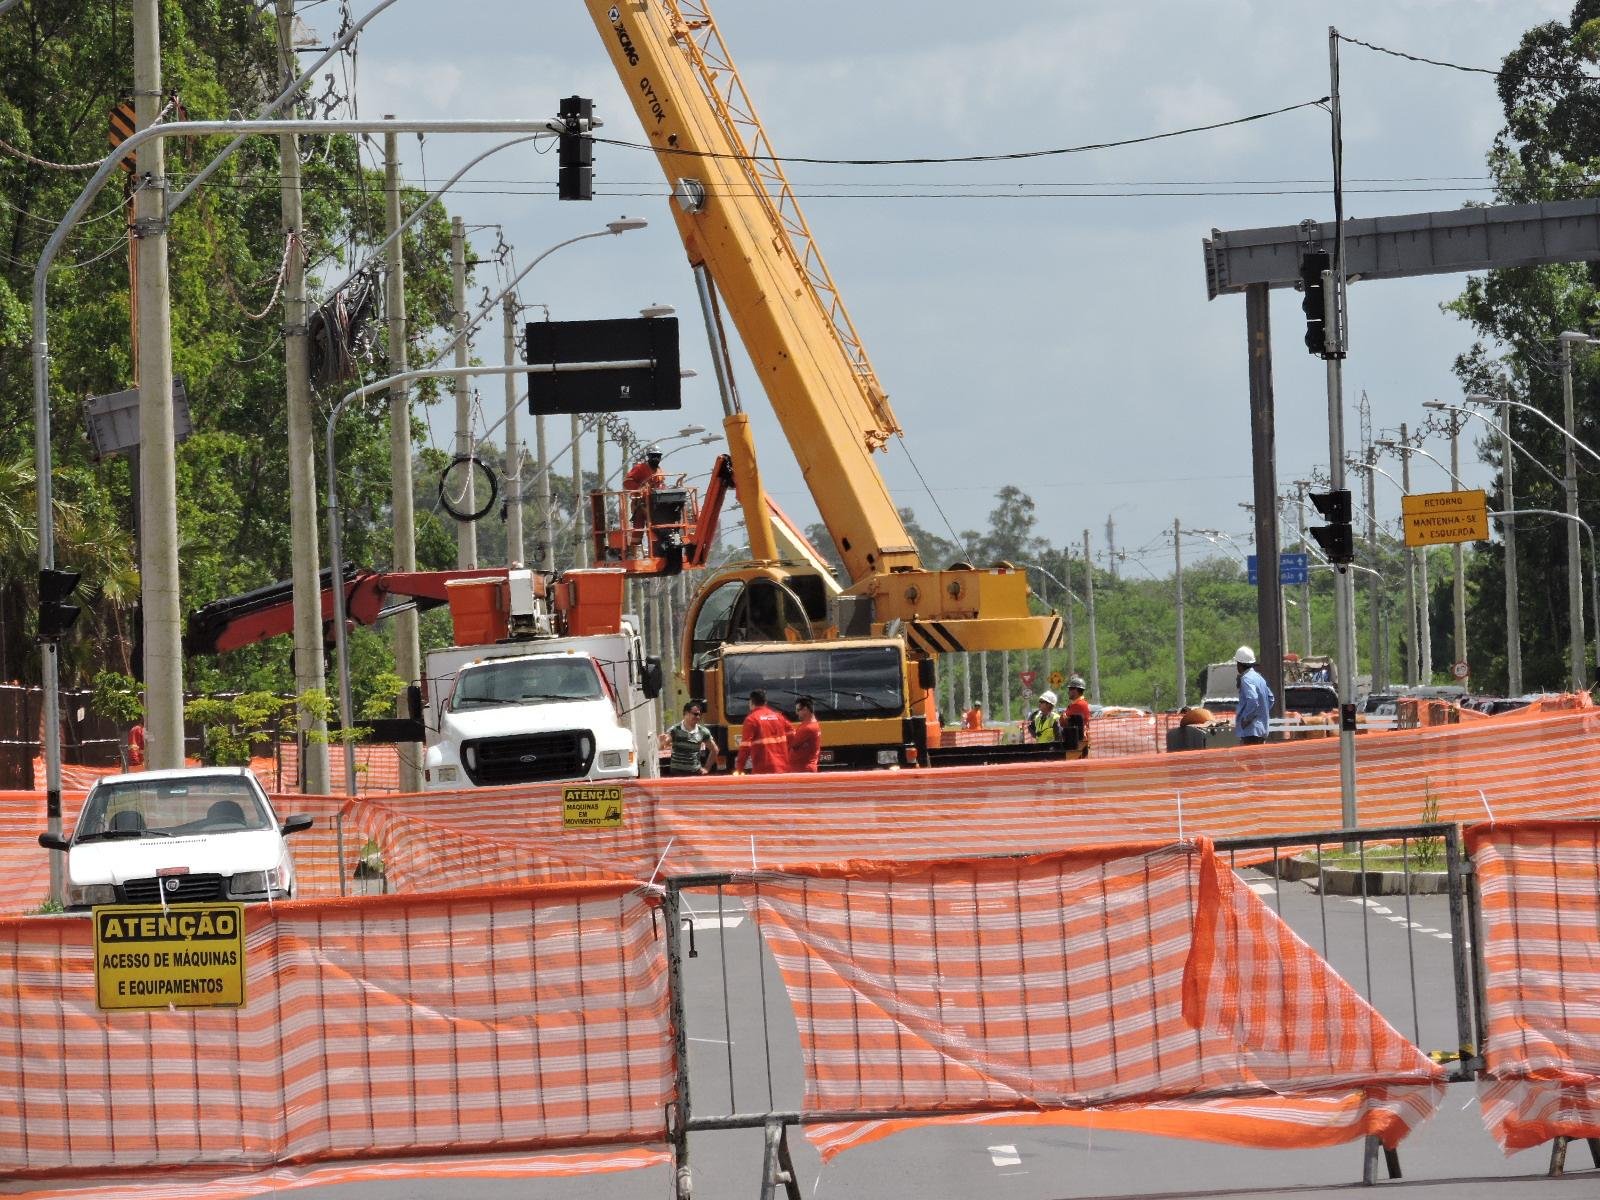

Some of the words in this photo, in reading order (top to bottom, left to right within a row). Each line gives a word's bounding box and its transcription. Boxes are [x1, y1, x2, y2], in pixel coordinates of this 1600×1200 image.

[614, 22, 640, 67] XCMG
[640, 77, 667, 125] QY70K
[1424, 497, 1463, 507] RETORNO
[1430, 527, 1476, 539] ESQUERDA
[566, 789, 619, 800] ATENÇÃO
[104, 911, 235, 941] ATENÇÃO
[102, 953, 150, 969] ACESSO
[153, 953, 170, 968] DE
[173, 948, 237, 967] MÁQUINAS
[118, 981, 126, 996] E
[129, 978, 224, 996] EQUIPAMENTOS
